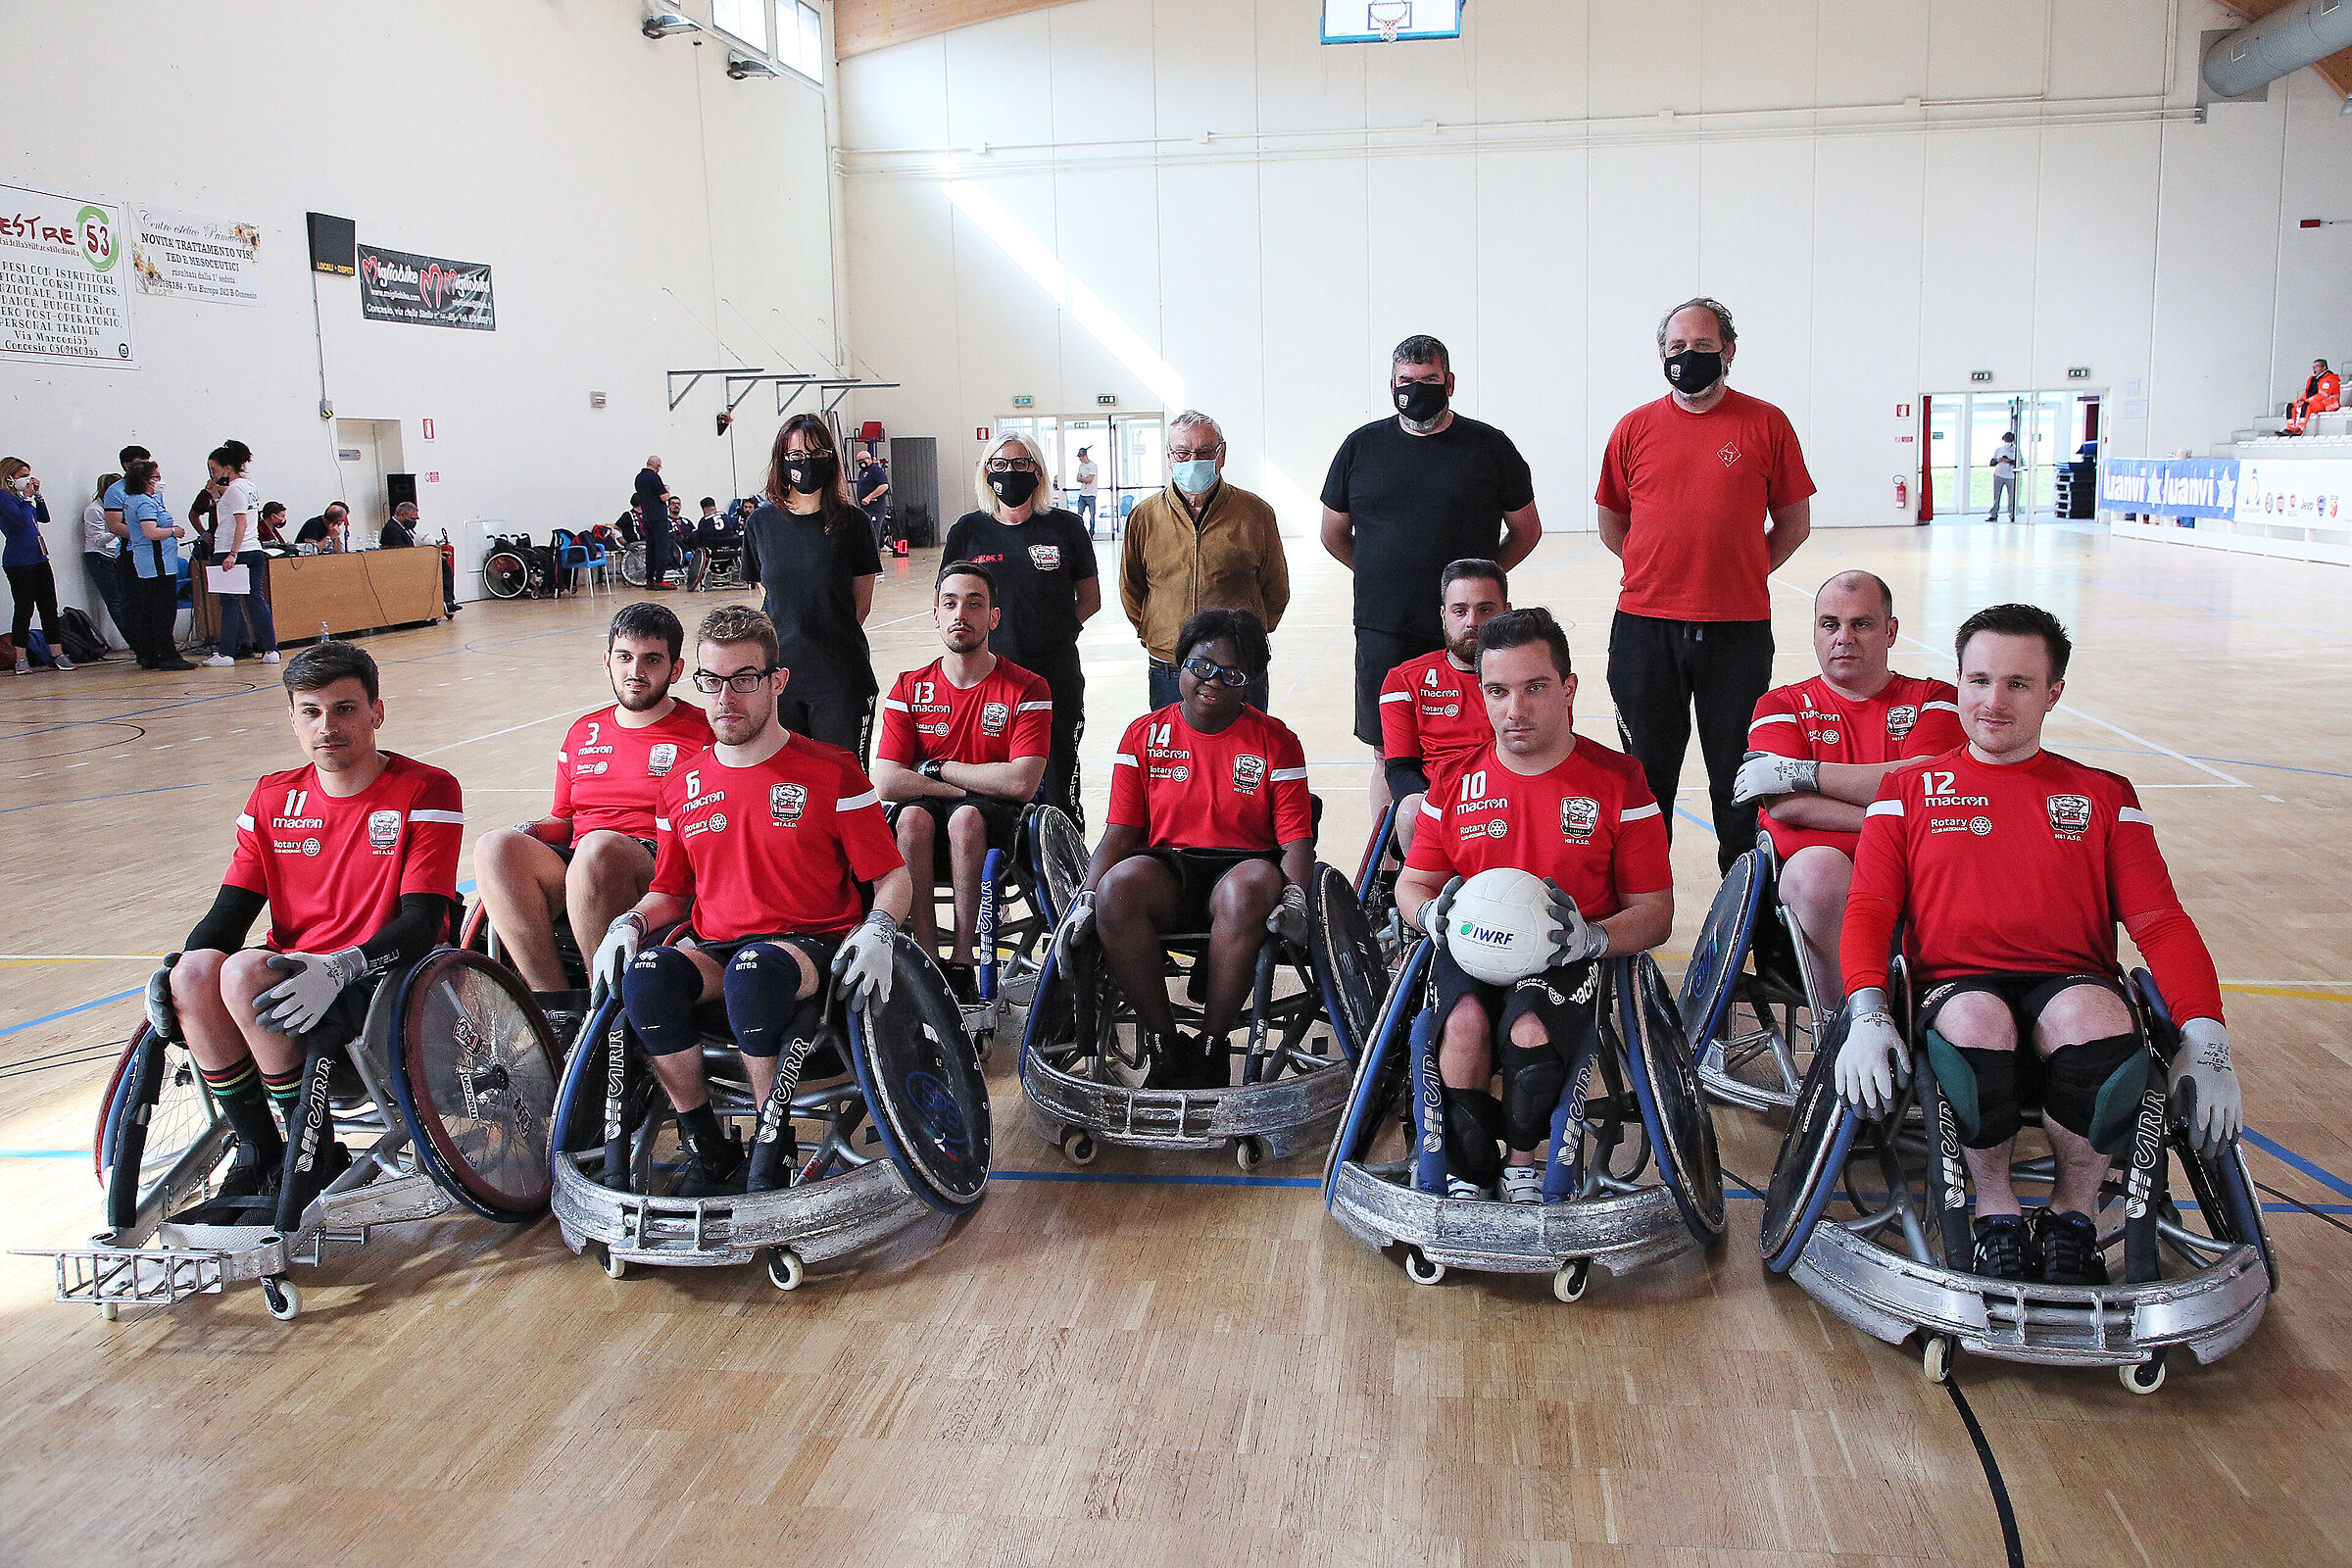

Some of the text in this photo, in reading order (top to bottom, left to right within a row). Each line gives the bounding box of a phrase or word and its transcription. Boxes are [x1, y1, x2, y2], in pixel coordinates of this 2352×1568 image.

[139, 209, 172, 232] Centro
[86, 223, 110, 257] 53
[175, 239, 236, 259] TRATTAMENTO
[2, 261, 114, 285] PESI CON ISTRUTTORI
[317, 262, 354, 275] LOCALI OSPITI
[362, 255, 419, 287] Migliobike
[42, 277, 74, 290] CORSI
[43, 299, 80, 313] BUNGEE
[14, 330, 32, 341] Via
[57, 323, 100, 336] TRAINER
[5, 340, 47, 352] Concesio
[2103, 466, 2215, 507] luanvi luanvi
[713, 514, 724, 531] 5
[893, 539, 908, 555] 40
[1425, 668, 1439, 688] 4
[914, 681, 935, 704] 13
[1420, 688, 1460, 699] macron
[1801, 693, 1813, 709] 1
[910, 704, 951, 713] macron
[585, 721, 601, 746] 3
[1147, 722, 1172, 748] 14
[577, 745, 613, 757] macron
[1147, 748, 1190, 760] macron
[685, 768, 701, 800] 6
[1461, 769, 1487, 802] 10
[1921, 770, 1956, 796] 12
[284, 788, 309, 817] 11
[682, 790, 726, 813] macron
[1456, 797, 1508, 815] macron
[1924, 796, 1989, 808] macron
[272, 817, 323, 829] macron
[684, 818, 708, 834] Rotary
[1460, 823, 1487, 835] Rotary
[1931, 818, 1968, 827] Rotary
[273, 840, 302, 849] Rotary
[1473, 927, 1514, 945] IWRF
[462, 1075, 478, 1120] macron
